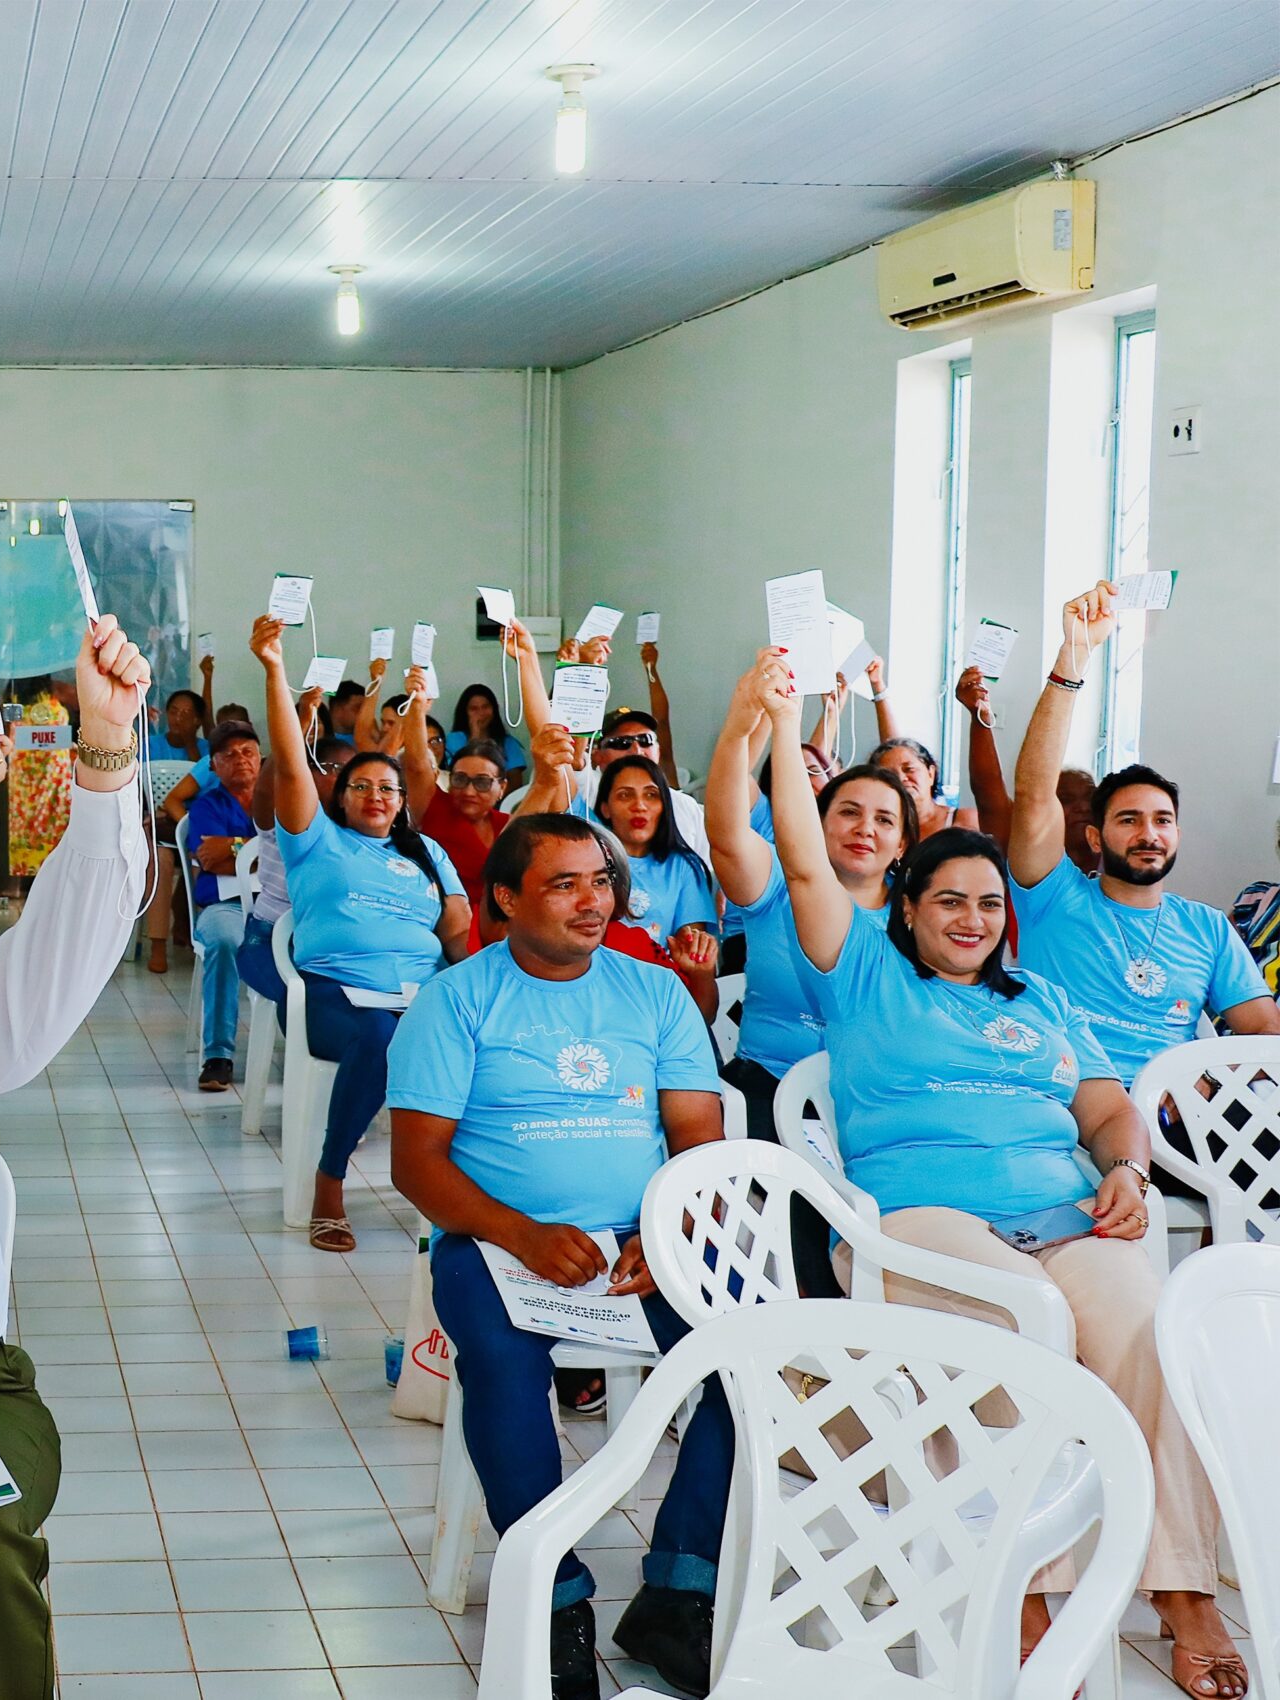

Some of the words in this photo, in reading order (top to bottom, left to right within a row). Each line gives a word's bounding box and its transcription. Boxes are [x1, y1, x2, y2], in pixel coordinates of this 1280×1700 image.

[31, 731, 56, 744] PUXE
[1119, 1020, 1150, 1033] SUAS:
[512, 1122, 527, 1132] 20
[530, 1120, 558, 1129] anos
[560, 1118, 576, 1128] do
[577, 1117, 612, 1128] SUAS:
[518, 1129, 569, 1143] proteção
[572, 1129, 602, 1139] social
[524, 1301, 554, 1311] SOCIAL
[583, 1311, 631, 1319] PROTEÇÃO
